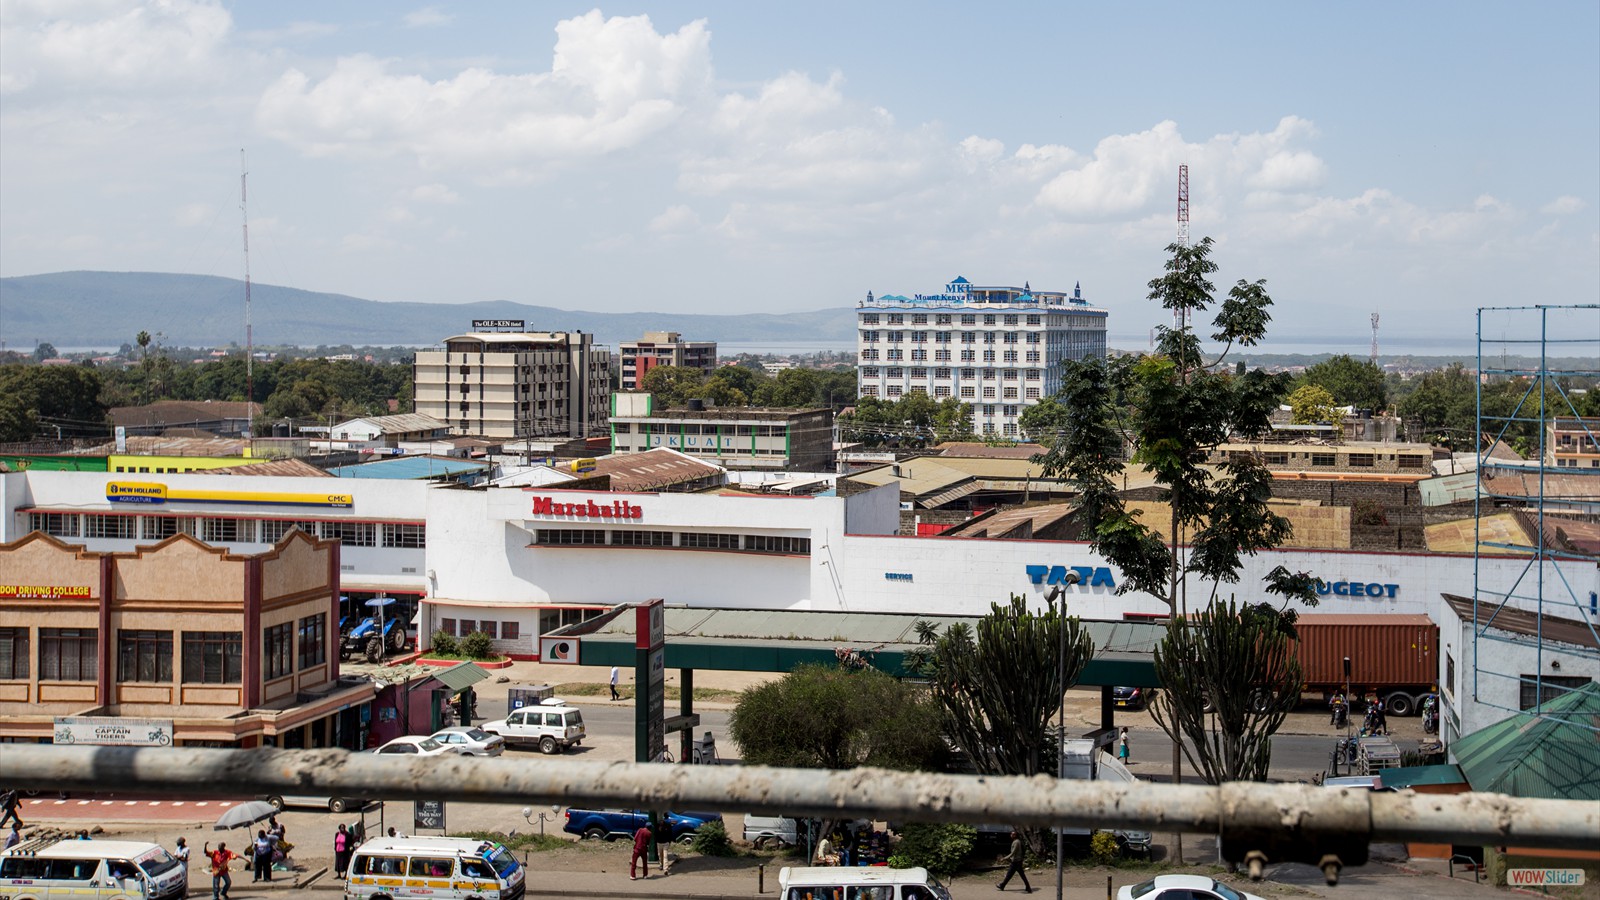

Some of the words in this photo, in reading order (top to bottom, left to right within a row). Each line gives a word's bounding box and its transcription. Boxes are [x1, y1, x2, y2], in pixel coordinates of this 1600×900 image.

[945, 284, 973, 293] MKU
[532, 496, 642, 519] Marshalls
[1026, 565, 1116, 587] TATA
[18, 586, 51, 595] DRIVING
[53, 586, 89, 595] COLLEGE
